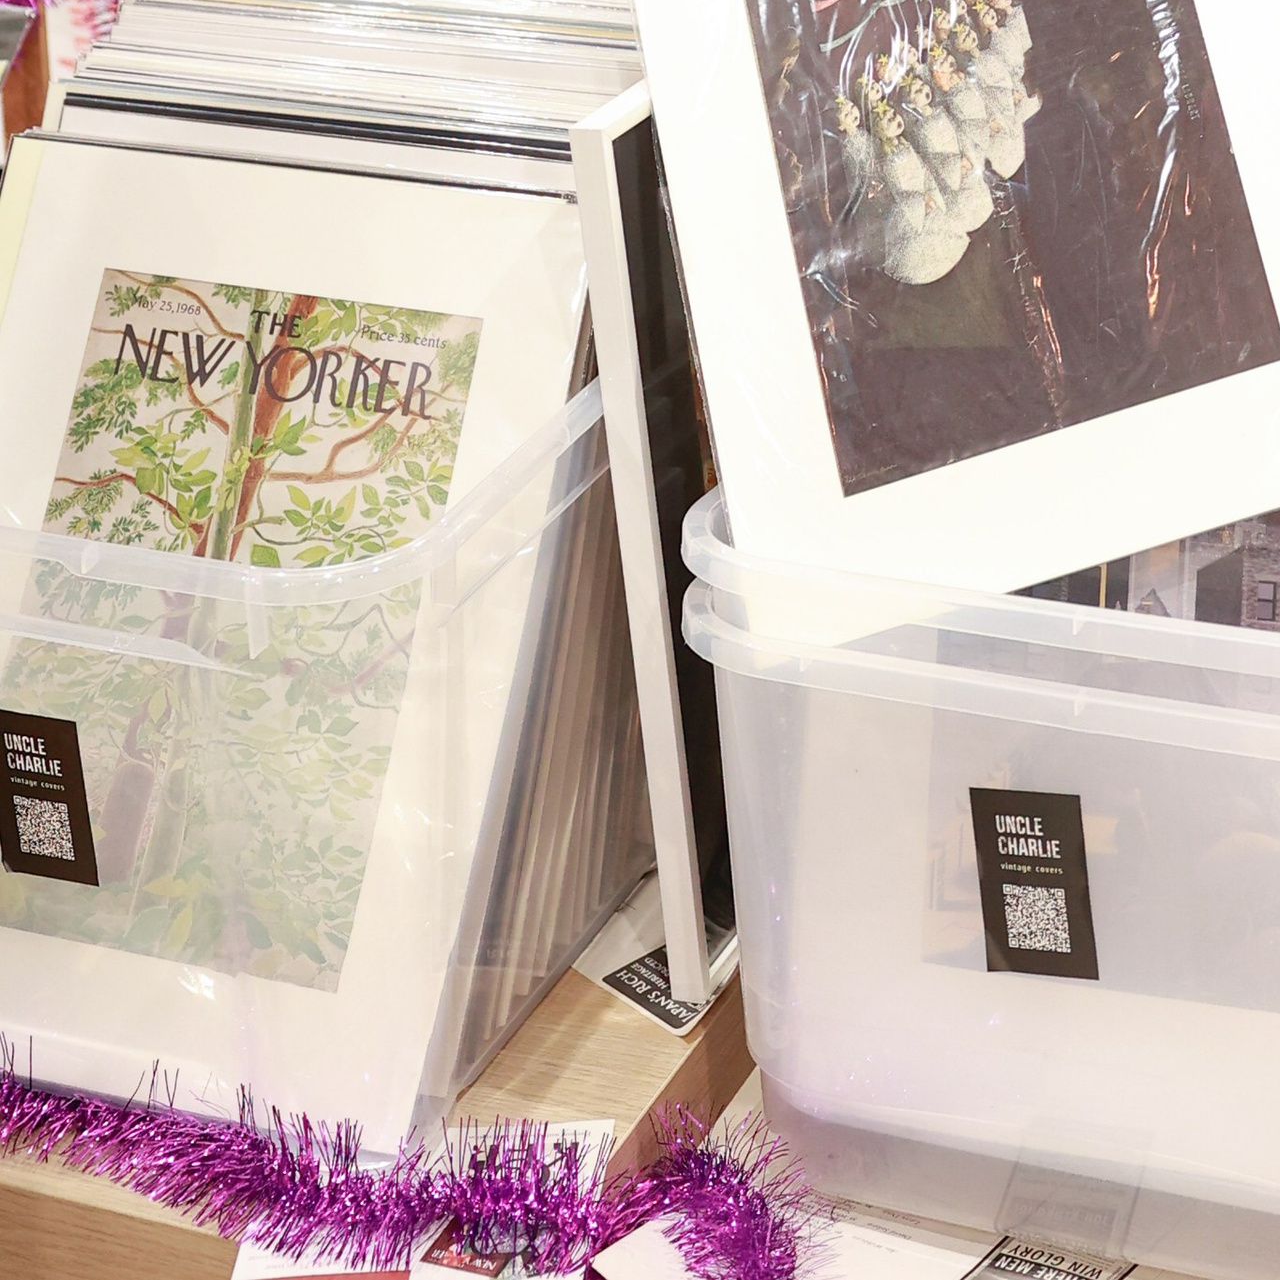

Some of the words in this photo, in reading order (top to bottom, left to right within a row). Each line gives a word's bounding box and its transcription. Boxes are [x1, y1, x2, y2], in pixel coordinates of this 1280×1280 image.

[131, 293, 158, 312] May
[159, 299, 201, 316] 25,1968
[250, 309, 302, 338] THE
[360, 324, 397, 343] Price
[397, 332, 411, 344] 35
[412, 333, 448, 350] cents
[113, 323, 237, 388] NEW
[244, 339, 434, 420] YORKER
[3, 732, 47, 756] UNCLE
[6, 751, 63, 777] CHARLIE
[10, 776, 38, 788] vintage
[40, 781, 65, 792] covers
[994, 814, 1044, 836] UNCLE
[998, 835, 1062, 859] CHARLIE
[1000, 862, 1032, 874] vintage
[1035, 864, 1063, 875] covers
[615, 969, 650, 995] RICH
[647, 990, 698, 1023] JAPAN'S
[994, 1255, 1035, 1275] MEN
[1008, 1244, 1065, 1266] GLORY
[1067, 1261, 1103, 1280] WIN
